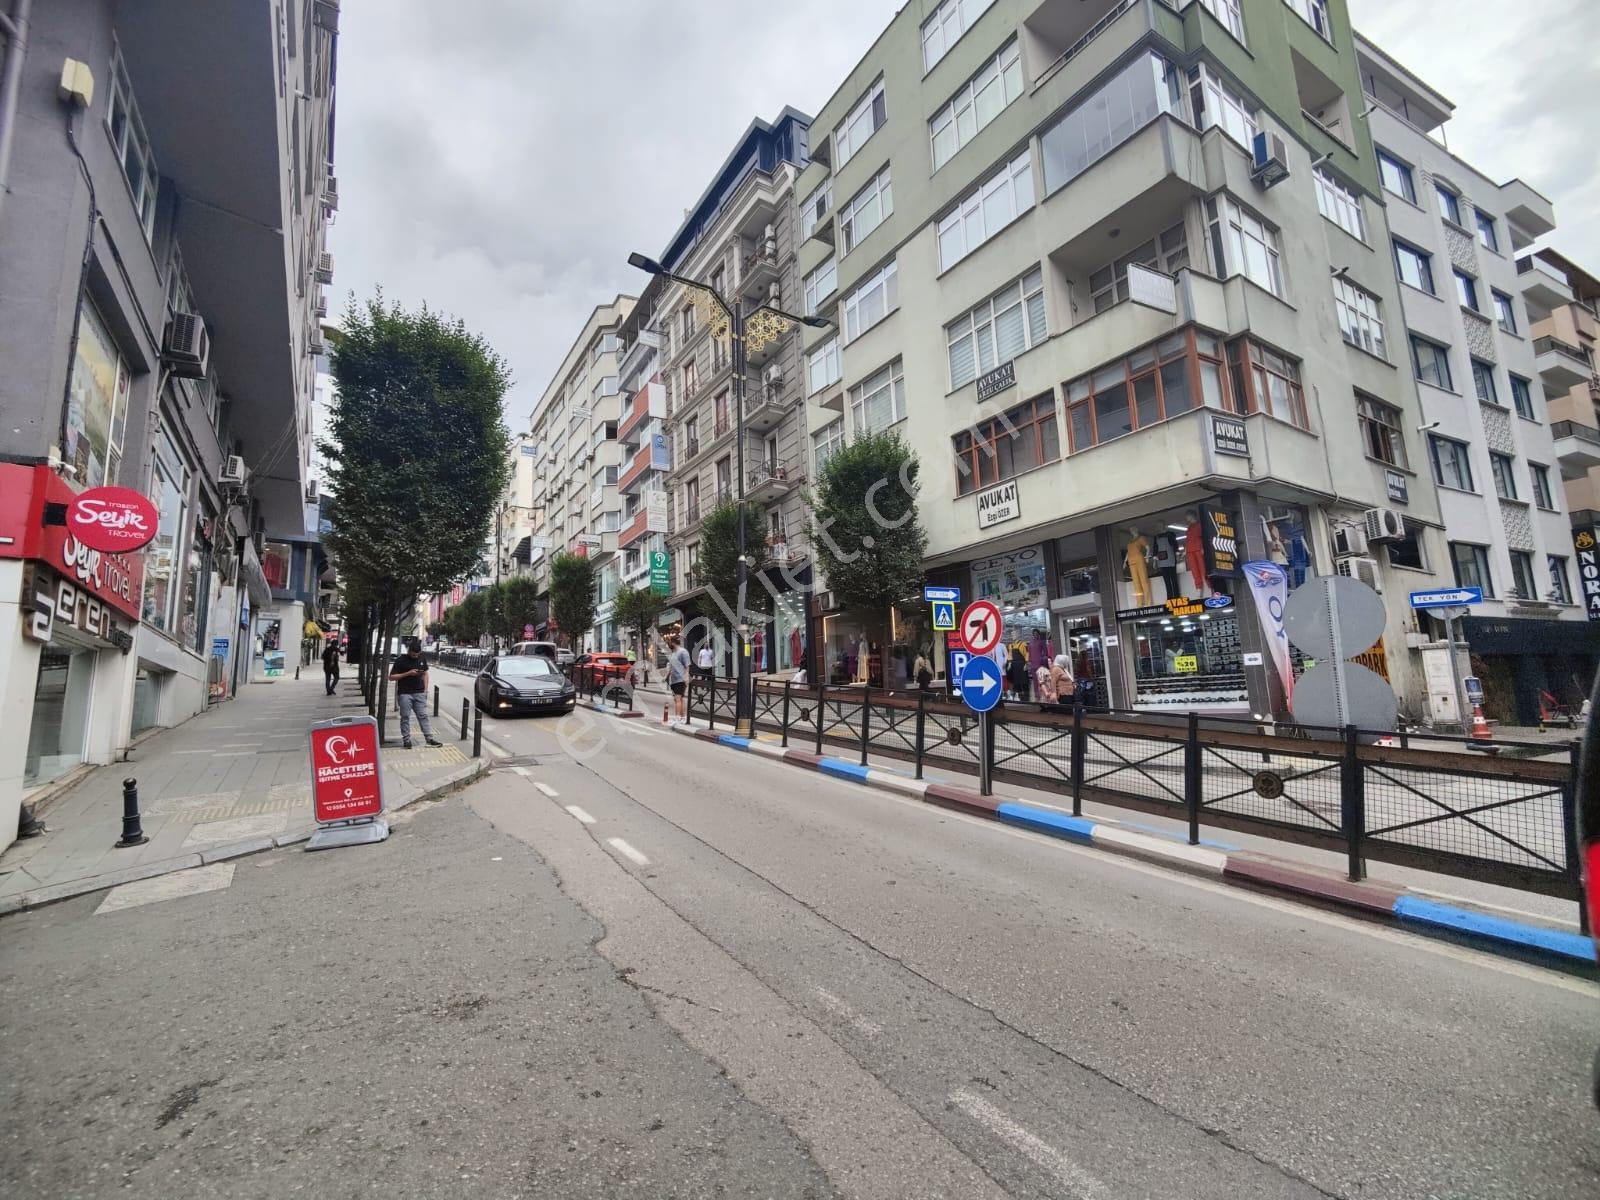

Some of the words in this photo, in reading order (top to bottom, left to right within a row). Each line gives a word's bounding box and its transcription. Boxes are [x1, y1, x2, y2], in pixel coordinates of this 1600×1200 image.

[979, 364, 1012, 389] AVUKAT
[1215, 421, 1244, 440] AVUKAT
[980, 484, 1015, 511] AVUKAT
[971, 549, 1037, 572] CEYO
[318, 763, 374, 777] HACETTEPE
